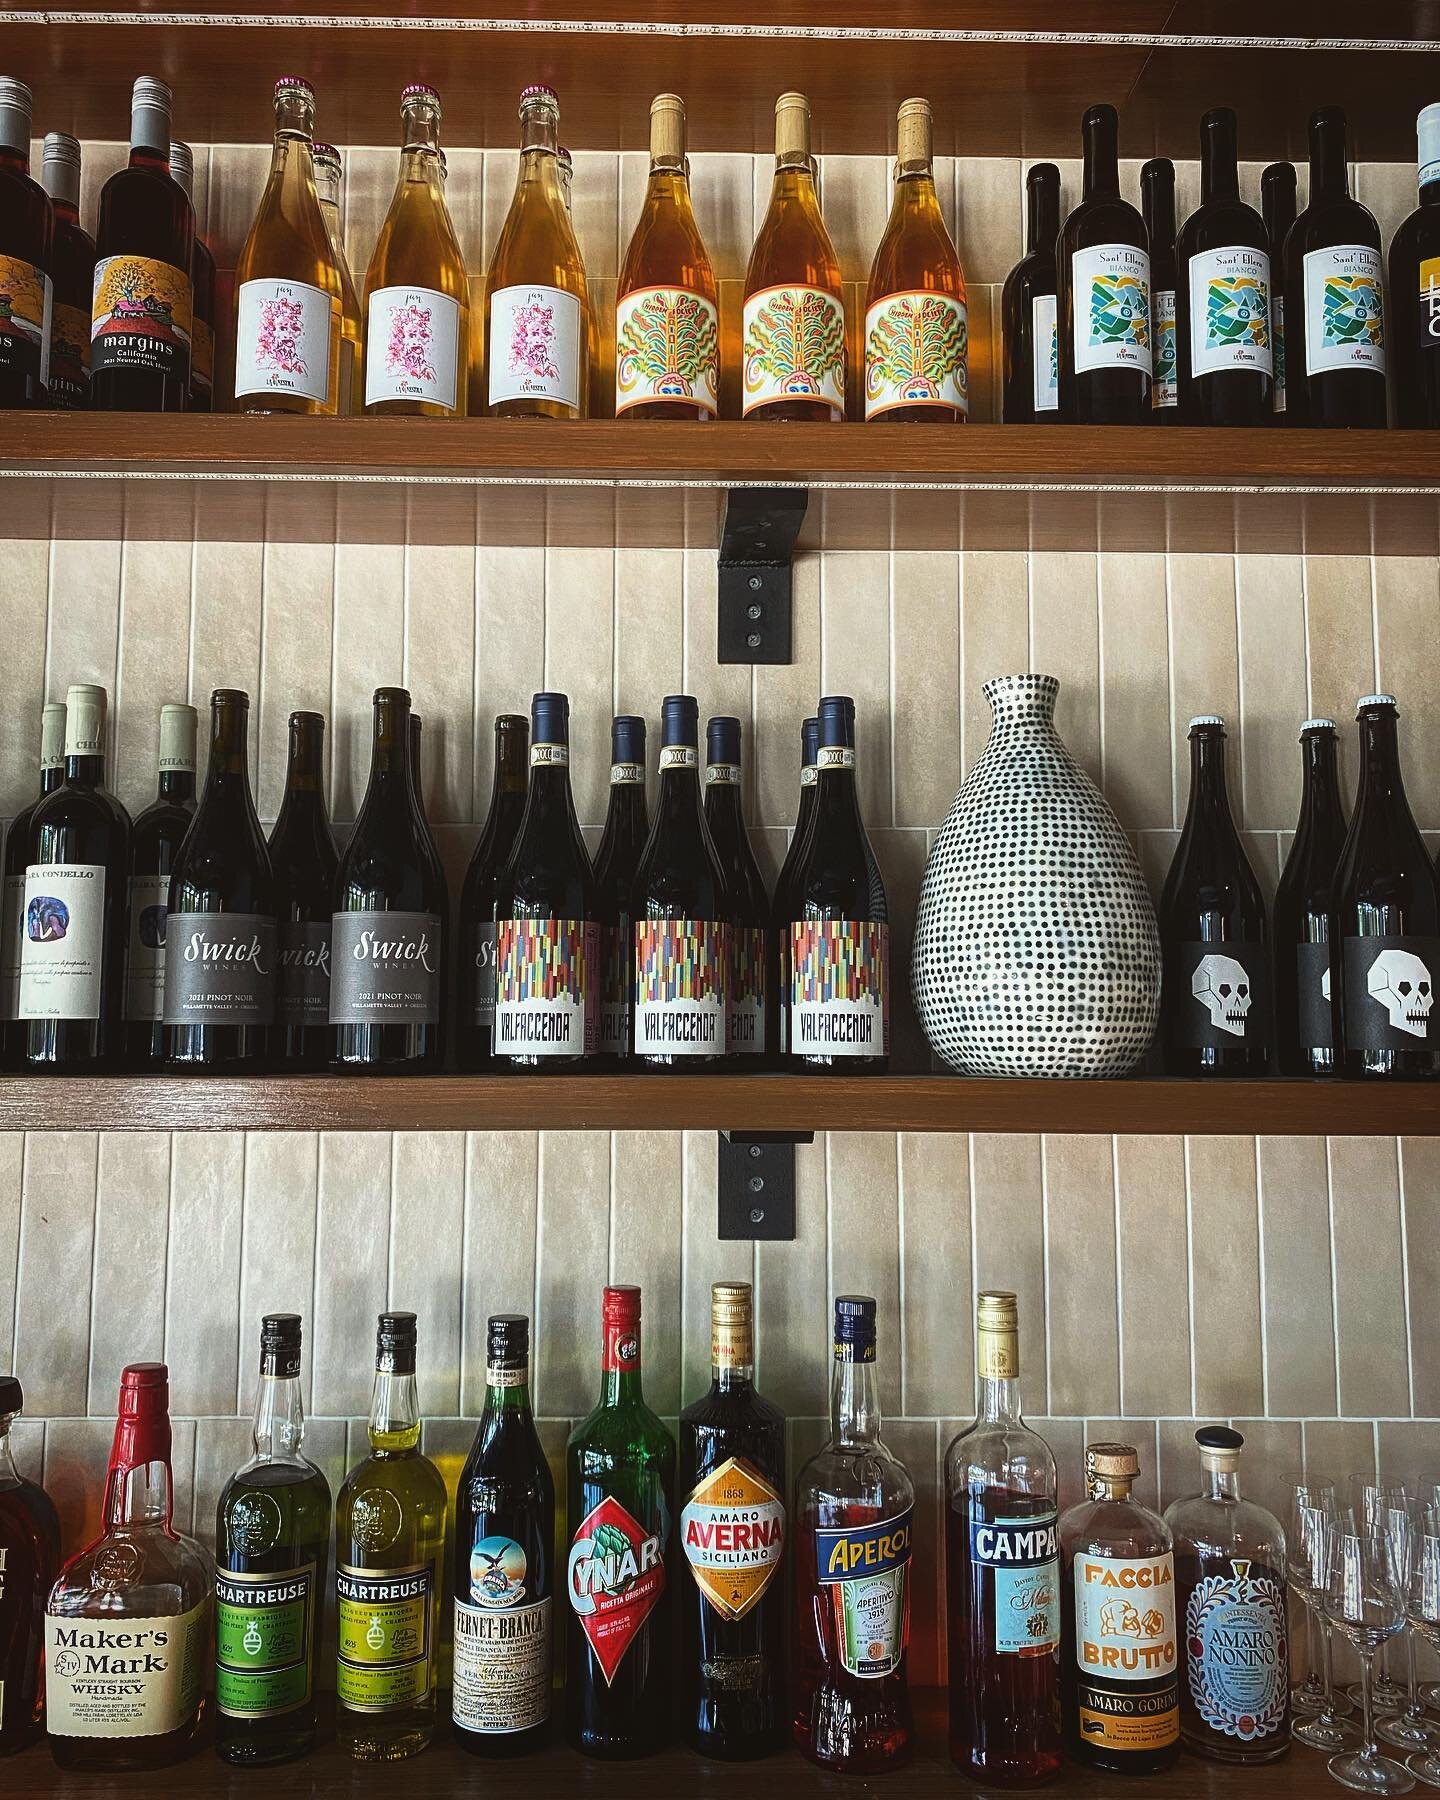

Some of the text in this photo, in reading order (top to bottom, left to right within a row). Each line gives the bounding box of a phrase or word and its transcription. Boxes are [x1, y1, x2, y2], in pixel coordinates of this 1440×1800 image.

[1109, 264, 1139, 274] BIANCO
[1226, 267, 1257, 275] BIANCO
[1343, 265, 1373, 275] BIANCO
[104, 336, 172, 355] margins
[117, 349, 157, 361] California
[42, 870, 94, 879] CONDELLO
[183, 933, 269, 975] Swick
[353, 930, 436, 973] Swick
[501, 1013, 571, 1041] VALFACCENDA
[644, 1013, 716, 1041] VALFACCENDA
[801, 1013, 872, 1043] VALFACCENDA
[723, 1489, 744, 1499] 1868
[710, 1511, 759, 1523] AMARO
[686, 1516, 784, 1552] AVERNA
[702, 1550, 769, 1563] SICILIANO
[828, 1525, 912, 1574] APEROL
[568, 1535, 660, 1615] CYNAR
[1085, 1563, 1172, 1588] FACCIA
[215, 1582, 306, 1604] CHARTREUSE
[337, 1578, 427, 1600] CHARTREUSE
[600, 1580, 654, 1610] RICETTA ORIGINALE
[856, 1590, 894, 1609] APERITIVO
[457, 1609, 543, 1639] FERNET-BRANCA
[868, 1608, 885, 1620] 1919
[54, 1627, 169, 1649] Maker's
[1209, 1628, 1274, 1649] AMARO
[61, 1654, 67, 1663] S
[83, 1654, 167, 1675] Mark
[1083, 1640, 1175, 1670] BRUTTO
[1209, 1646, 1275, 1666] NONINO
[71, 1684, 147, 1695] WHISKY
[1087, 1693, 1134, 1713] AMARO
